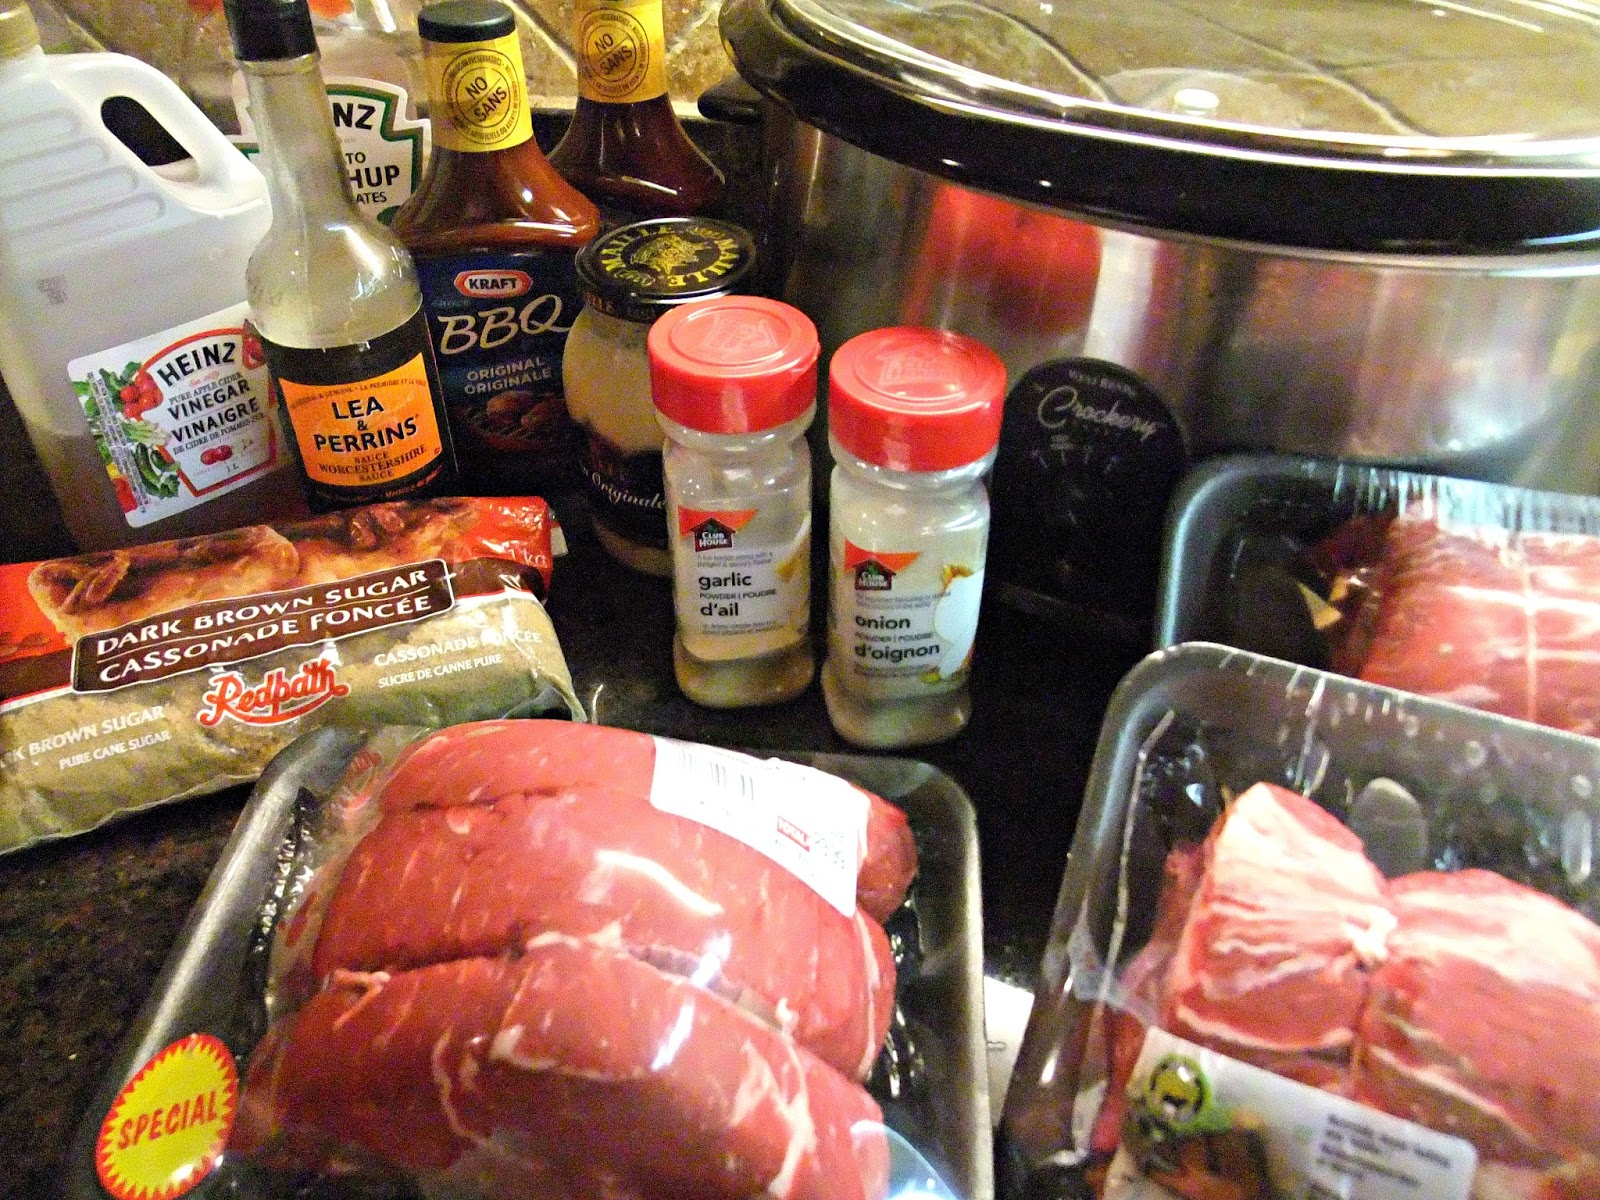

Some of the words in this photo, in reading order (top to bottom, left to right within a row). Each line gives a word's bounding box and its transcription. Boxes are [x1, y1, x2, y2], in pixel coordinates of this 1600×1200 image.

[595, 33, 614, 54] NO
[600, 45, 633, 75] SANS
[465, 77, 488, 100] NO
[474, 86, 507, 122] SANS
[468, 278, 518, 290] KRAFT
[437, 294, 571, 355] BBQ
[156, 342, 236, 387] HEINZ
[466, 357, 547, 382] ORIGINAL
[464, 368, 552, 395] ORIGINALE
[167, 378, 251, 420] VINEGAR
[331, 396, 384, 420] LEA
[171, 397, 260, 442] VINAIGRE
[313, 416, 417, 453] PERRINS
[357, 420, 368, 431] &
[318, 444, 427, 474] WORCESTERSHIRE
[354, 451, 389, 464] SAUCE
[359, 469, 394, 482] SAUCE
[698, 572, 752, 591] garlic
[700, 591, 738, 600] POWDER
[742, 588, 777, 599] POUDRE
[97, 619, 181, 656] DARK
[194, 596, 313, 631] BROWN
[325, 569, 428, 605] SUGAR
[700, 602, 740, 617] d'ail
[855, 615, 911, 630] onion
[99, 619, 300, 683] CASSONADE
[310, 595, 432, 631] FONCÉE
[373, 636, 478, 667] CASSONADE
[854, 643, 940, 663] d'oignon
[378, 672, 416, 689] SUCRE
[416, 668, 433, 680] DE
[433, 660, 473, 677] CANNE
[473, 653, 503, 668] PURE
[198, 657, 350, 726] Redpath
[28, 725, 98, 757] BROWN
[101, 705, 166, 735] SUGAR
[59, 751, 91, 770] PURE
[92, 743, 126, 760] CANE
[128, 729, 172, 751] SUGAR
[117, 1090, 217, 1150] SPECIAL
